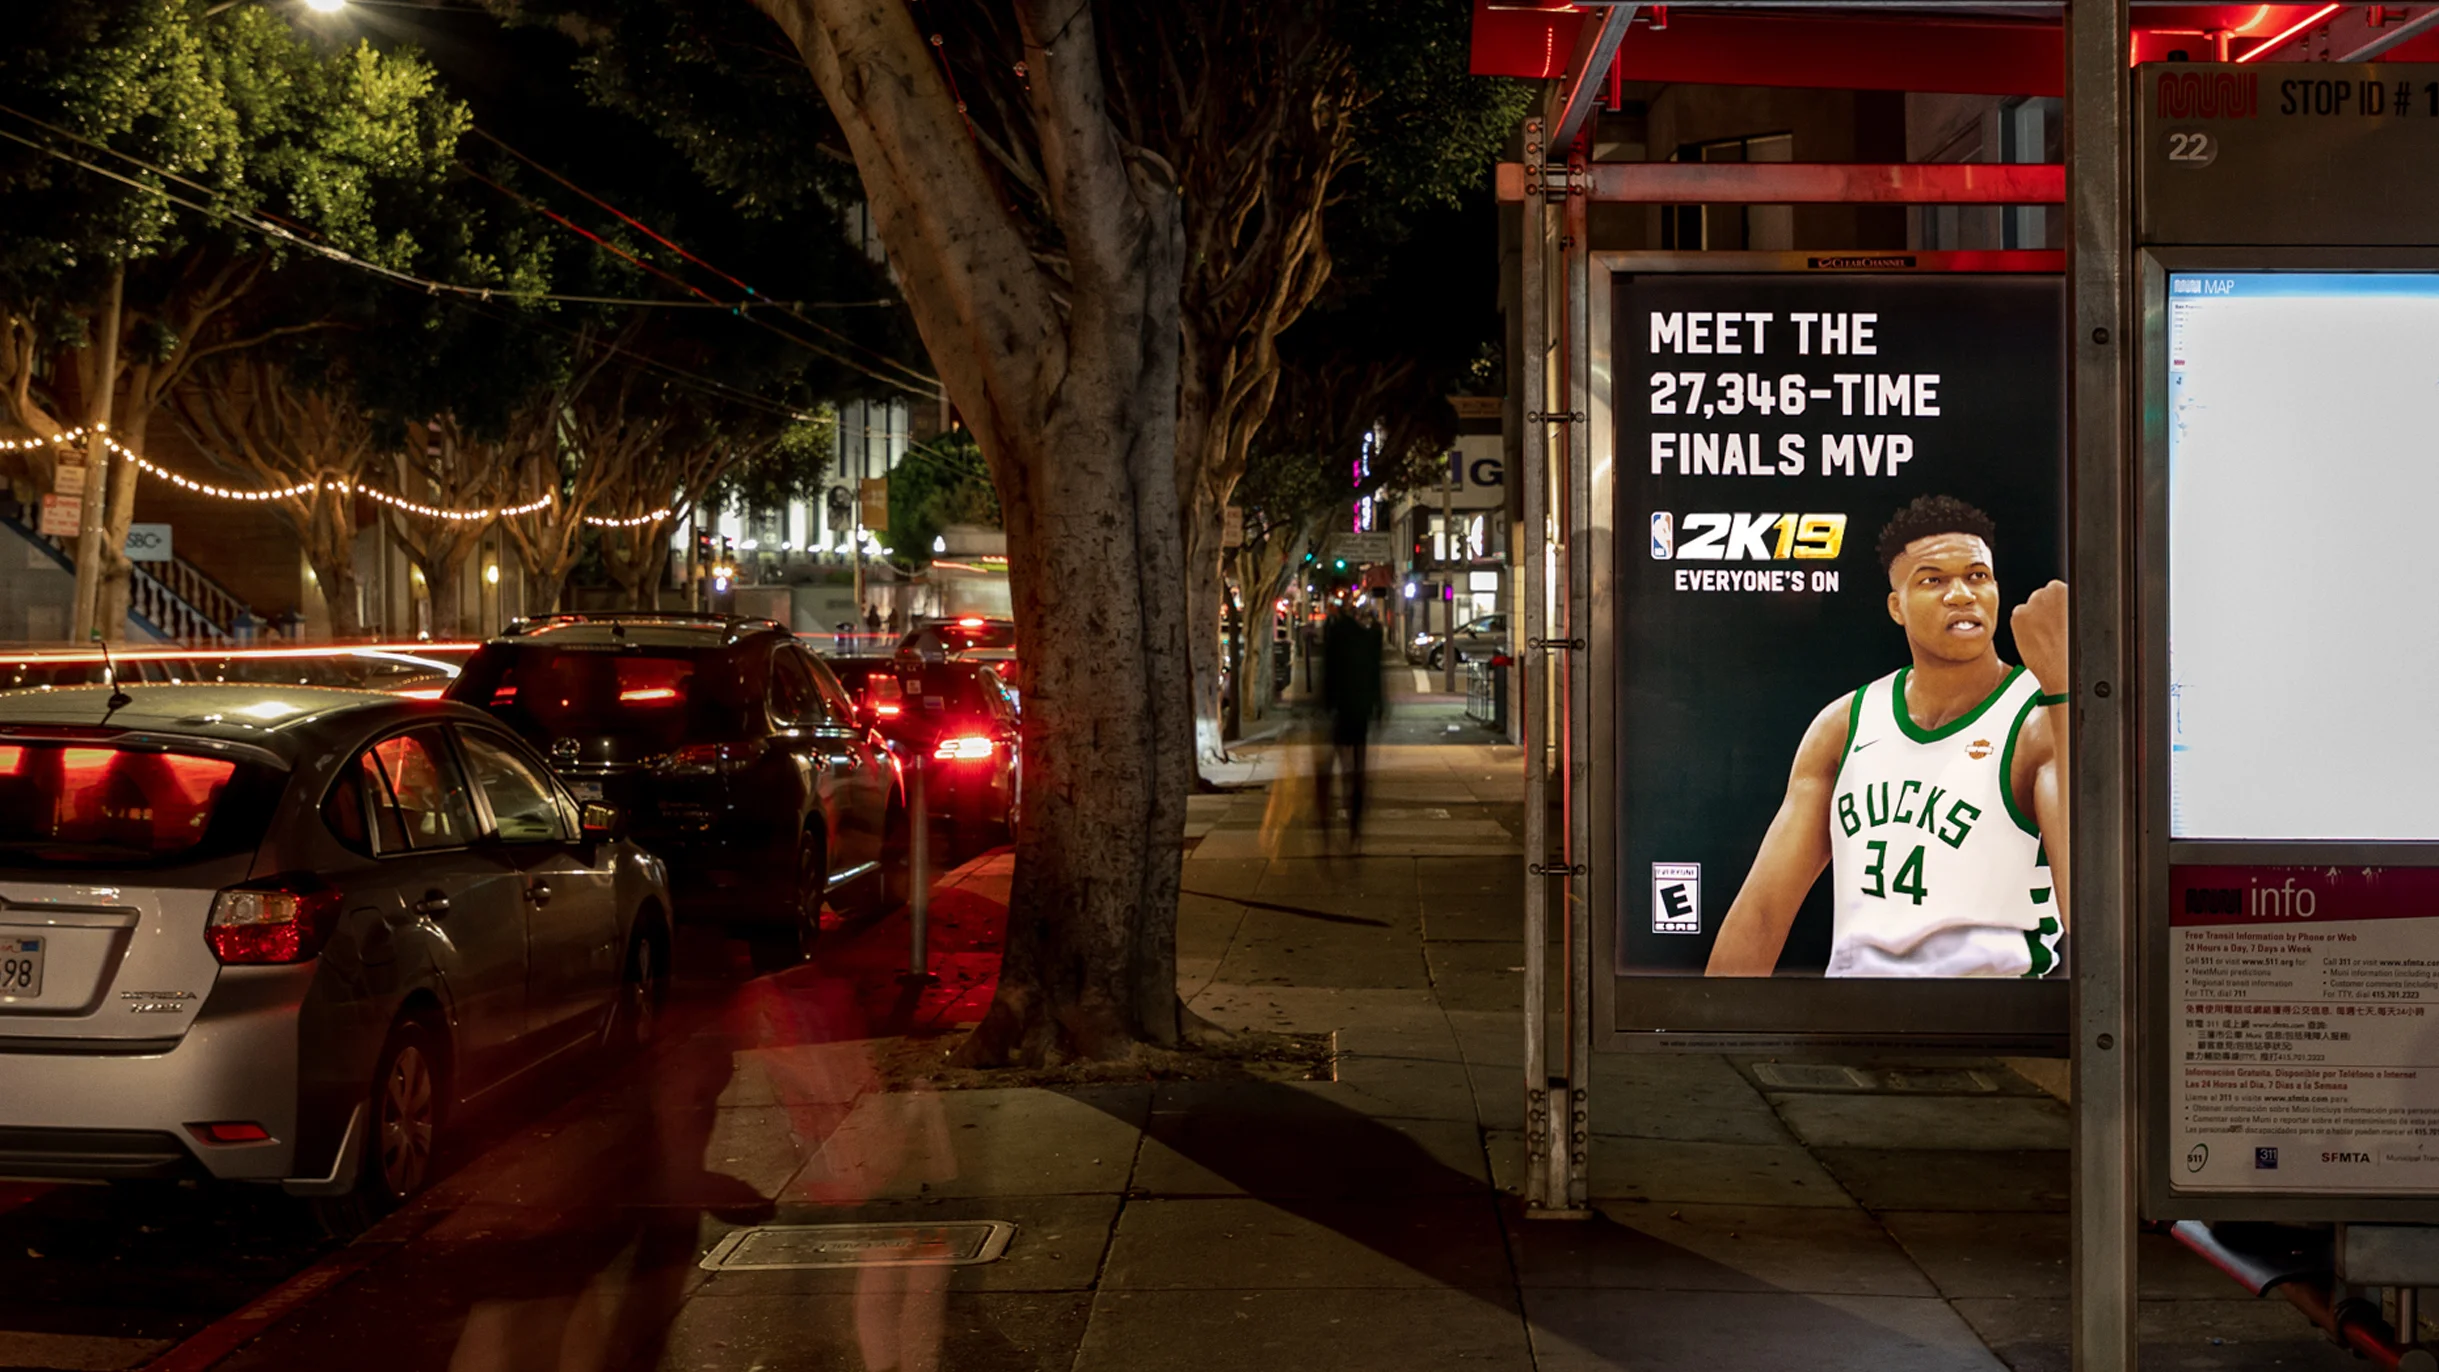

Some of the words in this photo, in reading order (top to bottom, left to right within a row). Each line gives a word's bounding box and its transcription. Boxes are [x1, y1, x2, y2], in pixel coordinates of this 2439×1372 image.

[2281, 80, 2351, 116] STOP
[2359, 81, 2384, 116] ID
[2169, 133, 2208, 160] 22
[2205, 280, 2234, 294] MAP
[1651, 312, 1773, 354] MEET
[1791, 313, 1877, 355] THE
[1651, 372, 1940, 420] 27,346-TIME
[1651, 433, 1805, 476] FINALS
[1822, 434, 1913, 477] MVP
[1675, 513, 1847, 560] 2K19
[1675, 570, 1805, 591] EVERYONE'S
[1812, 571, 1839, 592] ON
[1838, 780, 1981, 849] BUCKS
[1861, 840, 1927, 905] 34
[1660, 884, 1693, 918] E
[2251, 877, 2316, 918] info
[2185, 931, 2203, 940] Free
[2206, 932, 2234, 940] Transit
[2237, 932, 2284, 940] Information
[2287, 933, 2296, 942] by
[2299, 933, 2324, 941] Phone
[2337, 933, 2357, 941] Web
[2197, 944, 2221, 952] Hours
[2258, 945, 2278, 954] Days
[0, 958, 32, 987] 98
[2201, 957, 2213, 965] 511
[2242, 958, 2293, 967] www.511.org
[2201, 1080, 2210, 1088] 24
[2213, 1081, 2237, 1089] Horas
[2269, 1081, 2273, 1089] 7
[2314, 1082, 2347, 1090] Semana
[2275, 1069, 2320, 1078] Disponible
[2323, 1071, 2336, 1079] por
[2384, 1070, 2416, 1079] Internet
[2188, 1154, 2202, 1162] 511
[2260, 1149, 2276, 1159] 311
[2322, 1153, 2369, 1163] SFMTA
